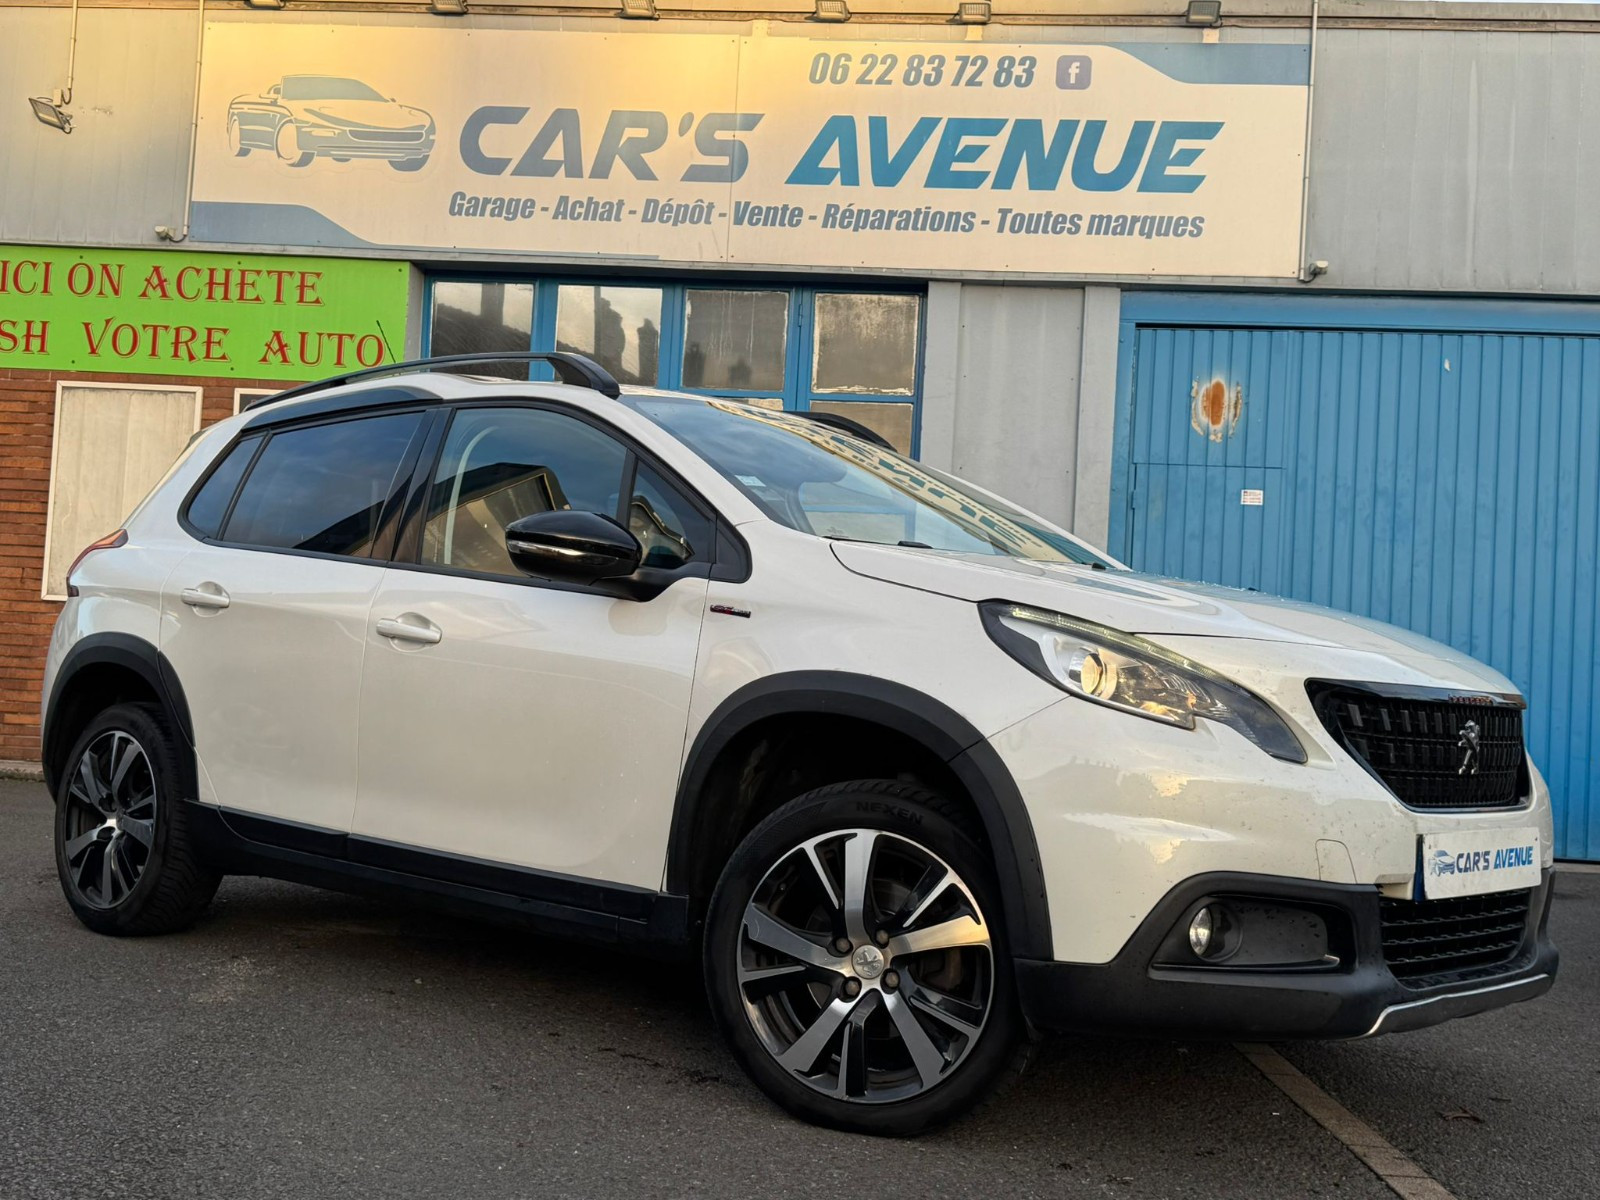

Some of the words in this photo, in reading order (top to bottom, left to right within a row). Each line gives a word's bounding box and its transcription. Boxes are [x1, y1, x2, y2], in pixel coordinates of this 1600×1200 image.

[808, 52, 852, 85] 06
[855, 53, 898, 86] 22
[902, 54, 946, 87] 83
[950, 55, 989, 87] 72
[992, 55, 1037, 88] 83
[459, 105, 765, 184] CAR'S
[785, 115, 1225, 193] AVENUE
[449, 191, 536, 222] Garage
[552, 195, 624, 222] Achat
[641, 198, 715, 226] Dépôt
[732, 201, 804, 228] Vente
[821, 203, 976, 232] Réparations
[997, 207, 1083, 235] Toutes
[1086, 211, 1205, 239] marques
[0, 260, 53, 296] ICI
[66, 263, 125, 298] ON
[138, 265, 324, 306] ACHETE
[82, 316, 230, 362] VOTRE
[258, 330, 386, 368] AUTO
[856, 800, 923, 825] NEXEN
[1456, 850, 1491, 873] CAR'S
[1493, 845, 1534, 870] AVENUE
